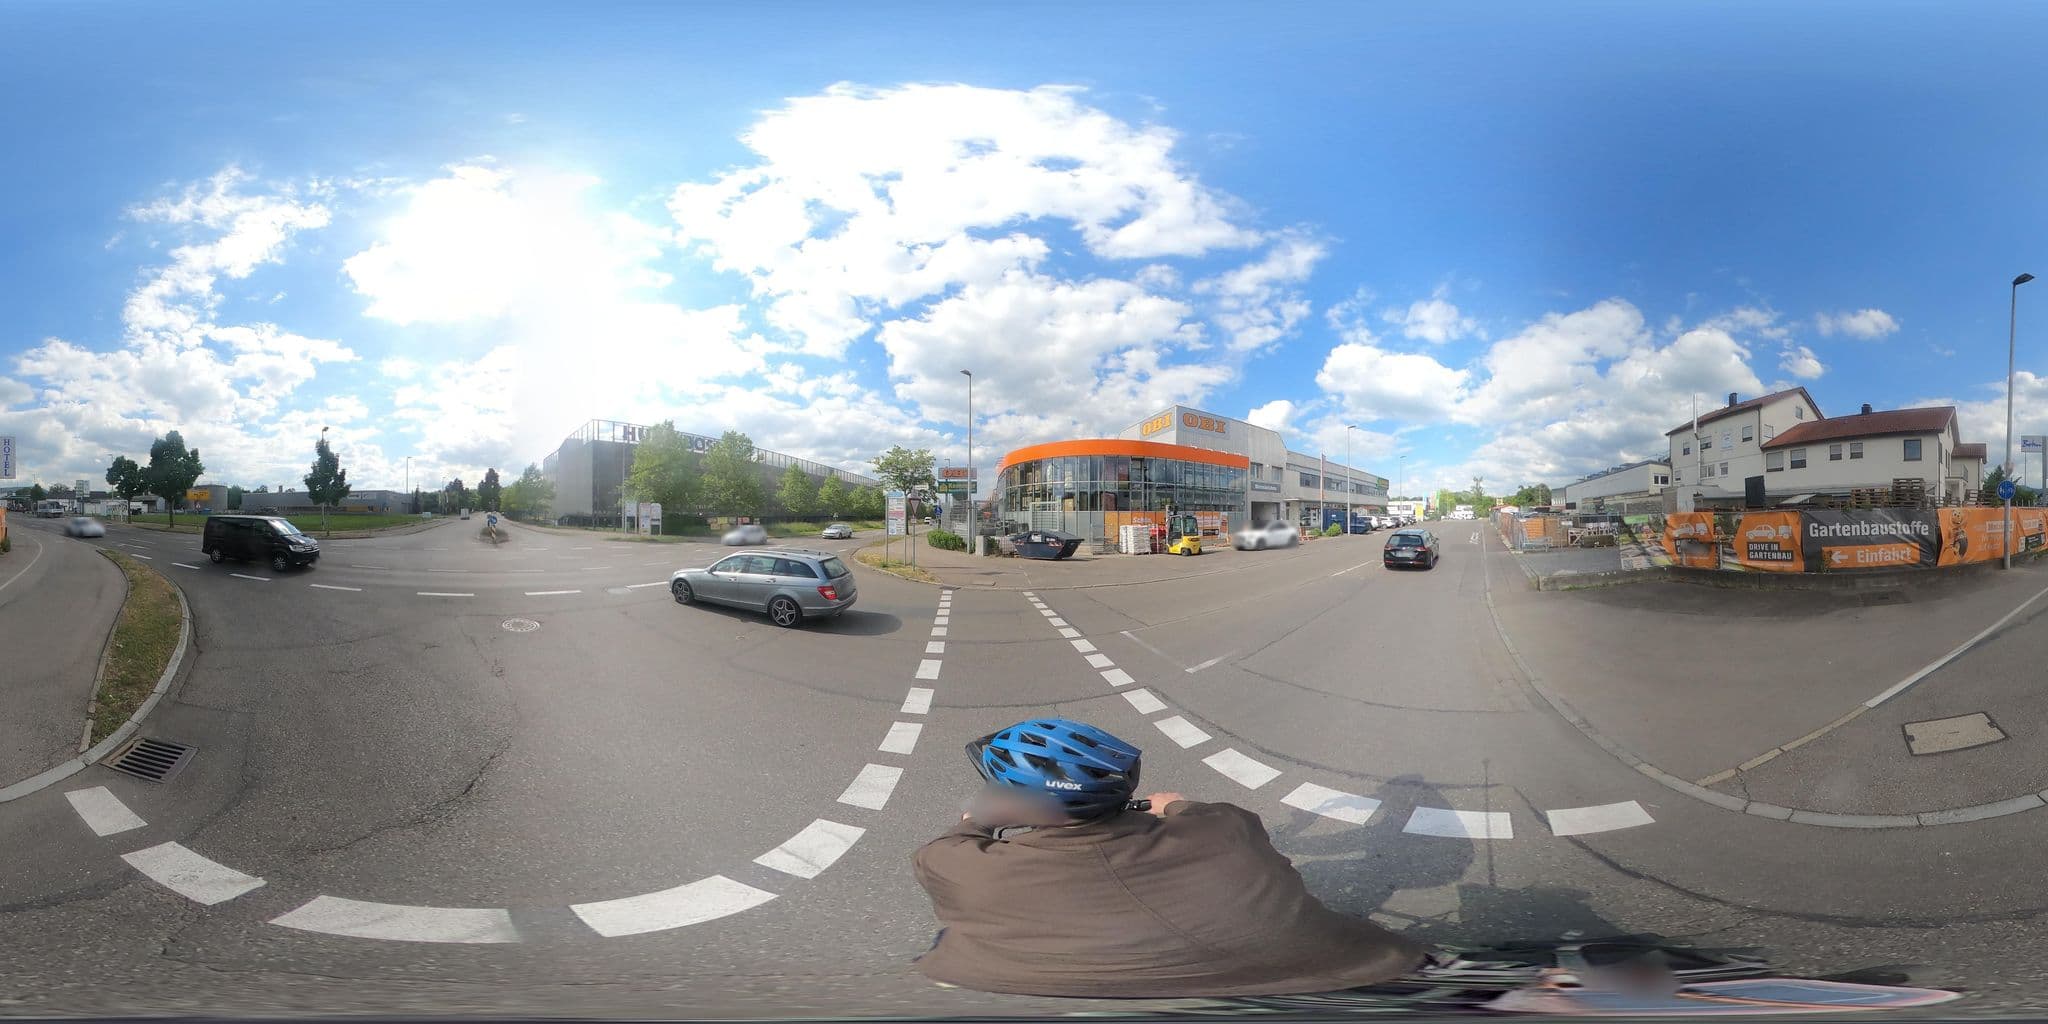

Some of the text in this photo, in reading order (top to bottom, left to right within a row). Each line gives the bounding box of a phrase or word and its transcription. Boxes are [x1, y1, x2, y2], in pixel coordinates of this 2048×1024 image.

[1142, 413, 1172, 437] OBI
[1183, 412, 1226, 434] OBI
[3, 438, 11, 476] HOTEL
[1809, 520, 1929, 537] Gartenbaustoffe
[1748, 551, 1792, 560] GARTENBAU
[1749, 543, 1779, 551] DRIVE IN
[1856, 547, 1913, 564] Einfahrt
[1045, 779, 1082, 791] uvex
